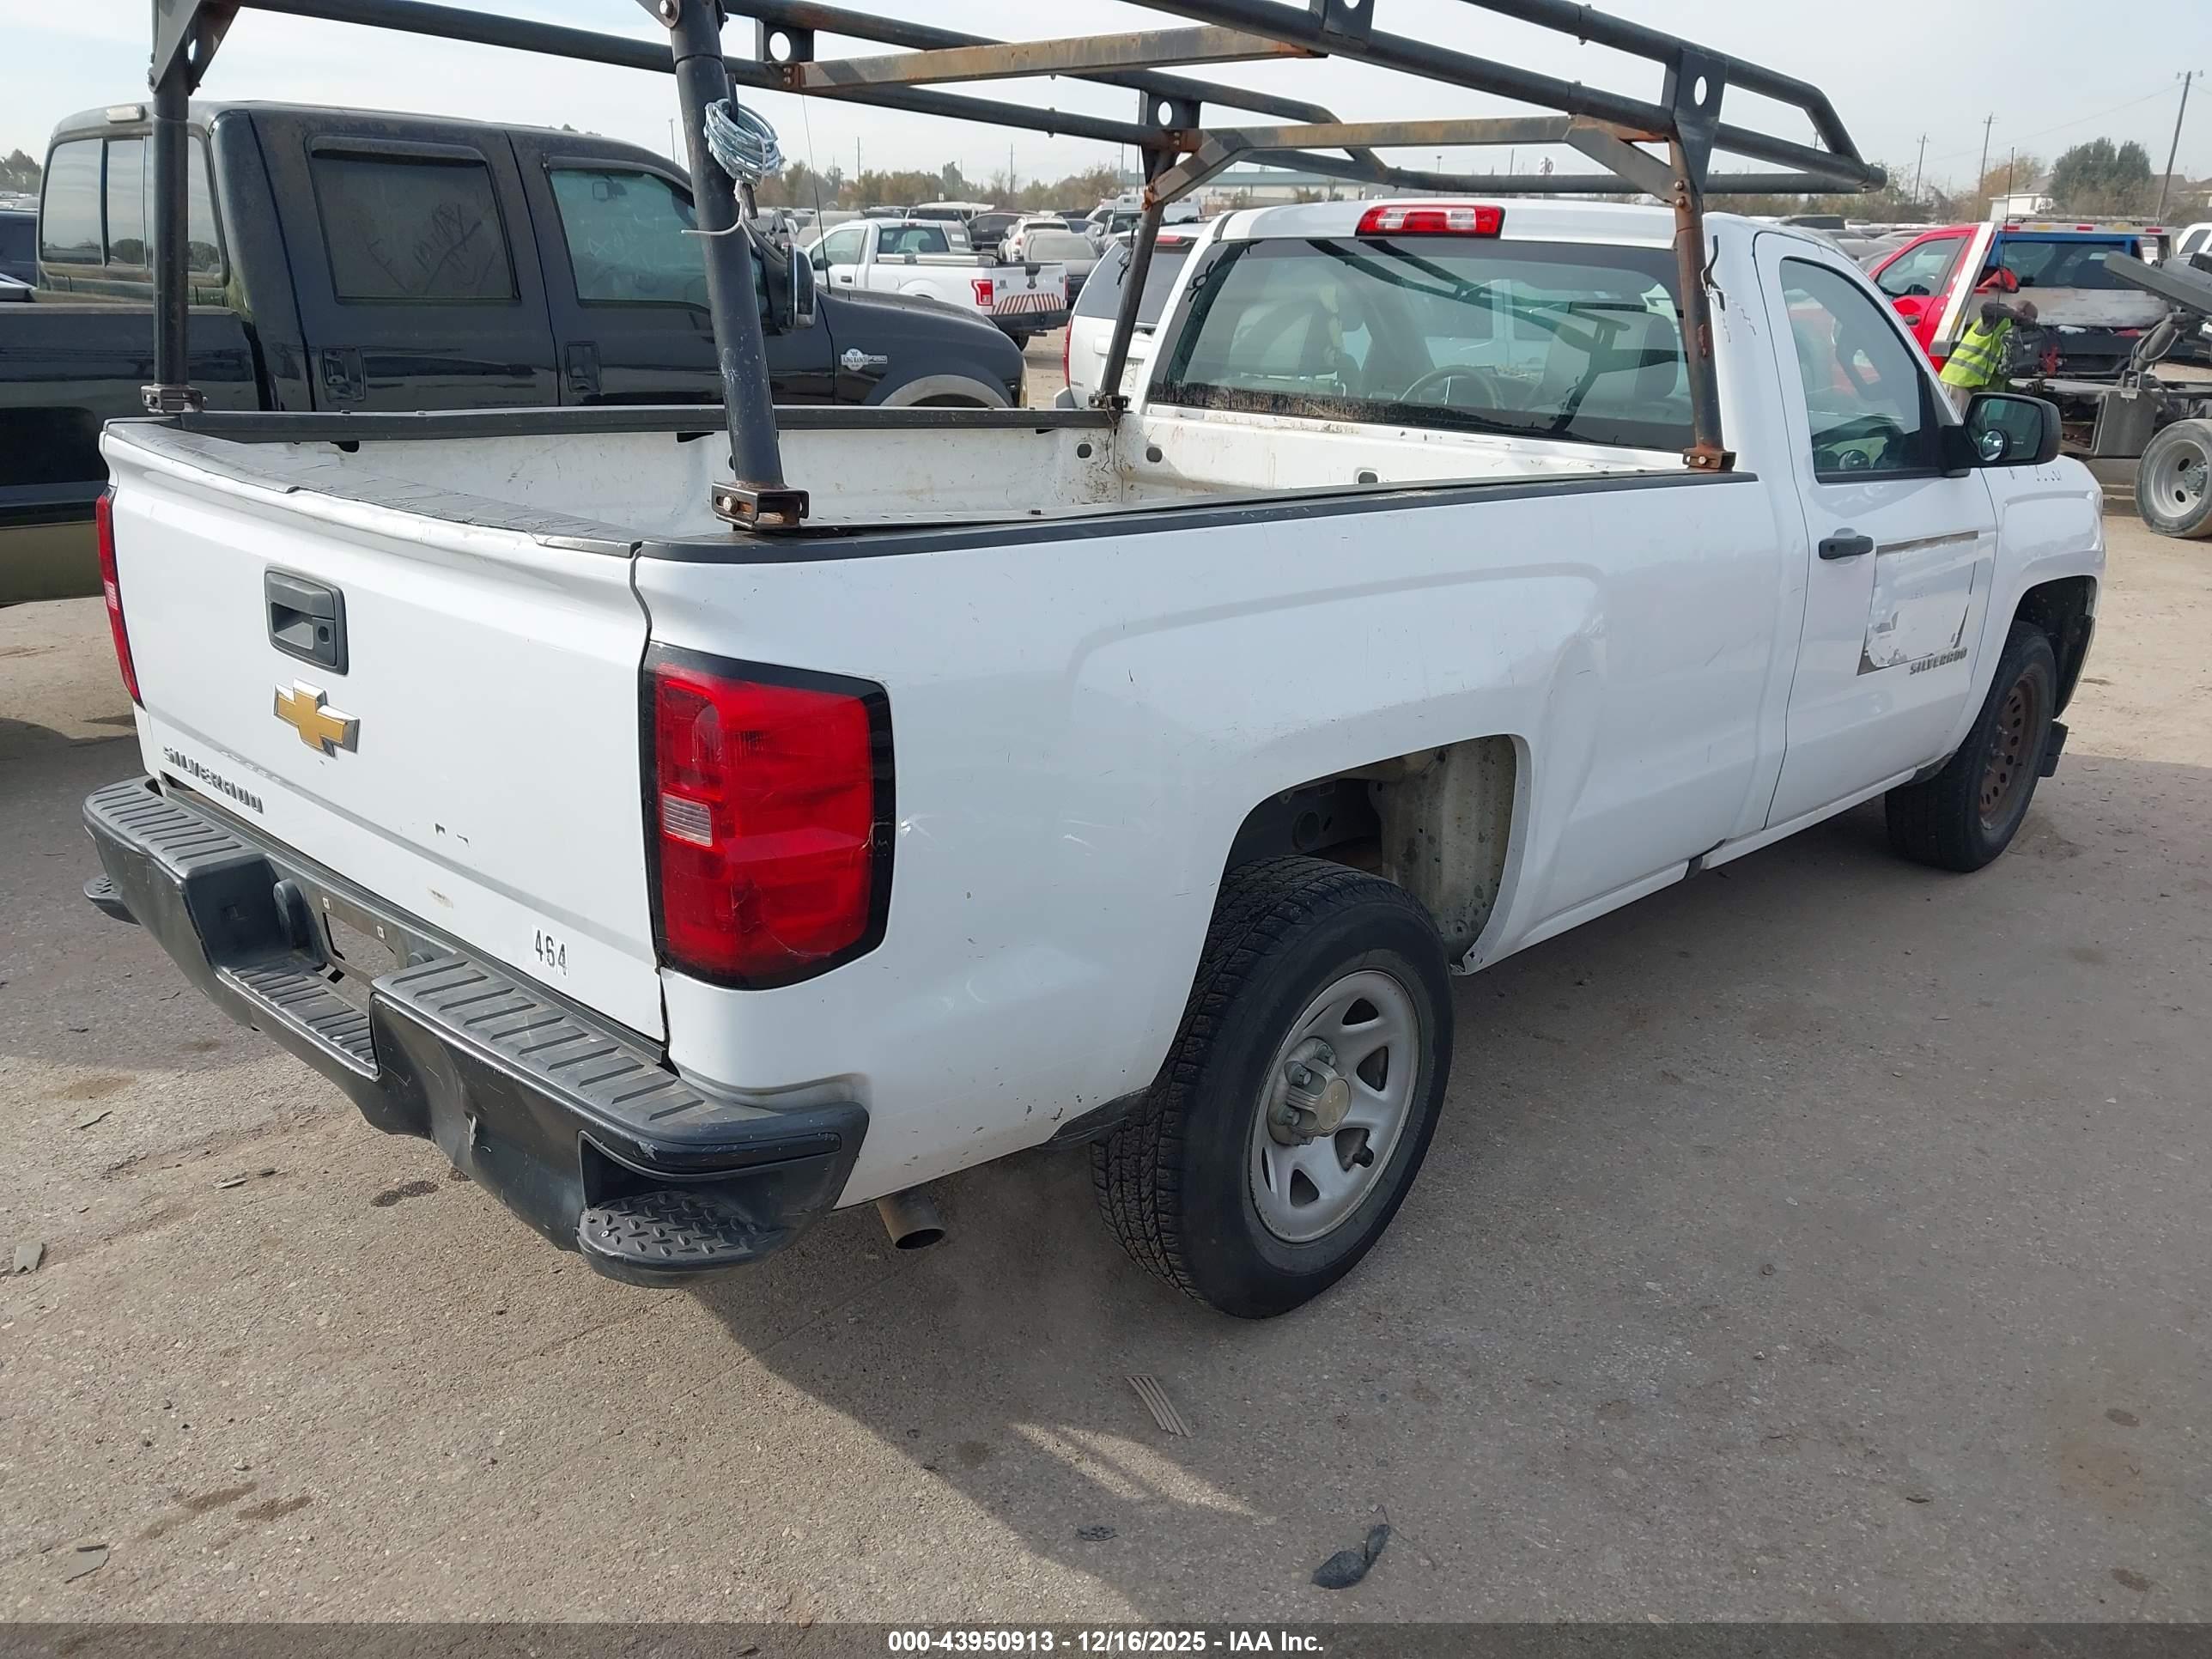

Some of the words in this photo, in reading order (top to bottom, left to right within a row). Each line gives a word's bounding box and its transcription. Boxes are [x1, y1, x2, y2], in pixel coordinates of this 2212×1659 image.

[1909, 647, 1967, 676] SILVERADO
[163, 746, 264, 815] SILVERADO
[535, 928, 568, 976] 464
